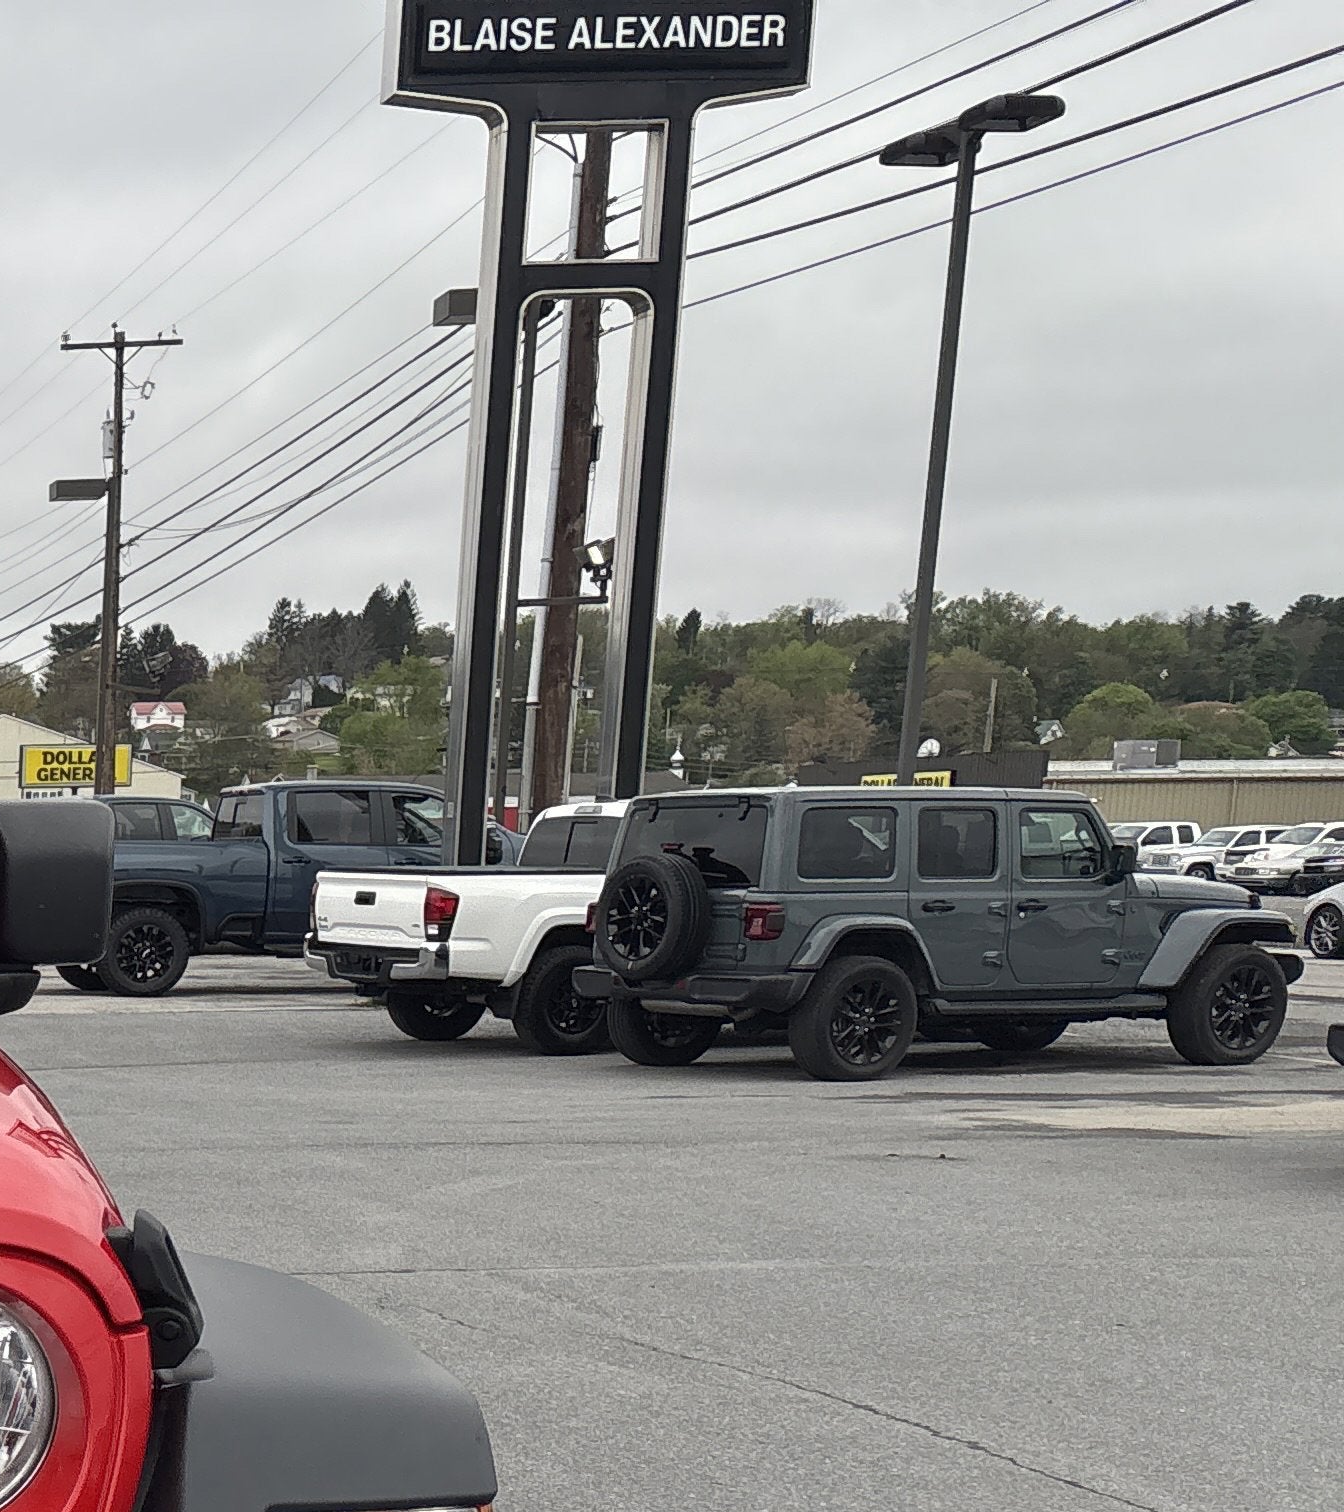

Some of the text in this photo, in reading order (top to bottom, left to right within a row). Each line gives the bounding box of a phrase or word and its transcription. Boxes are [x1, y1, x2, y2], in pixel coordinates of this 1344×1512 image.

[427, 14, 787, 52] BLAISE ALEXANDER
[41, 750, 97, 766] DOLLA
[36, 767, 116, 782] GENER
